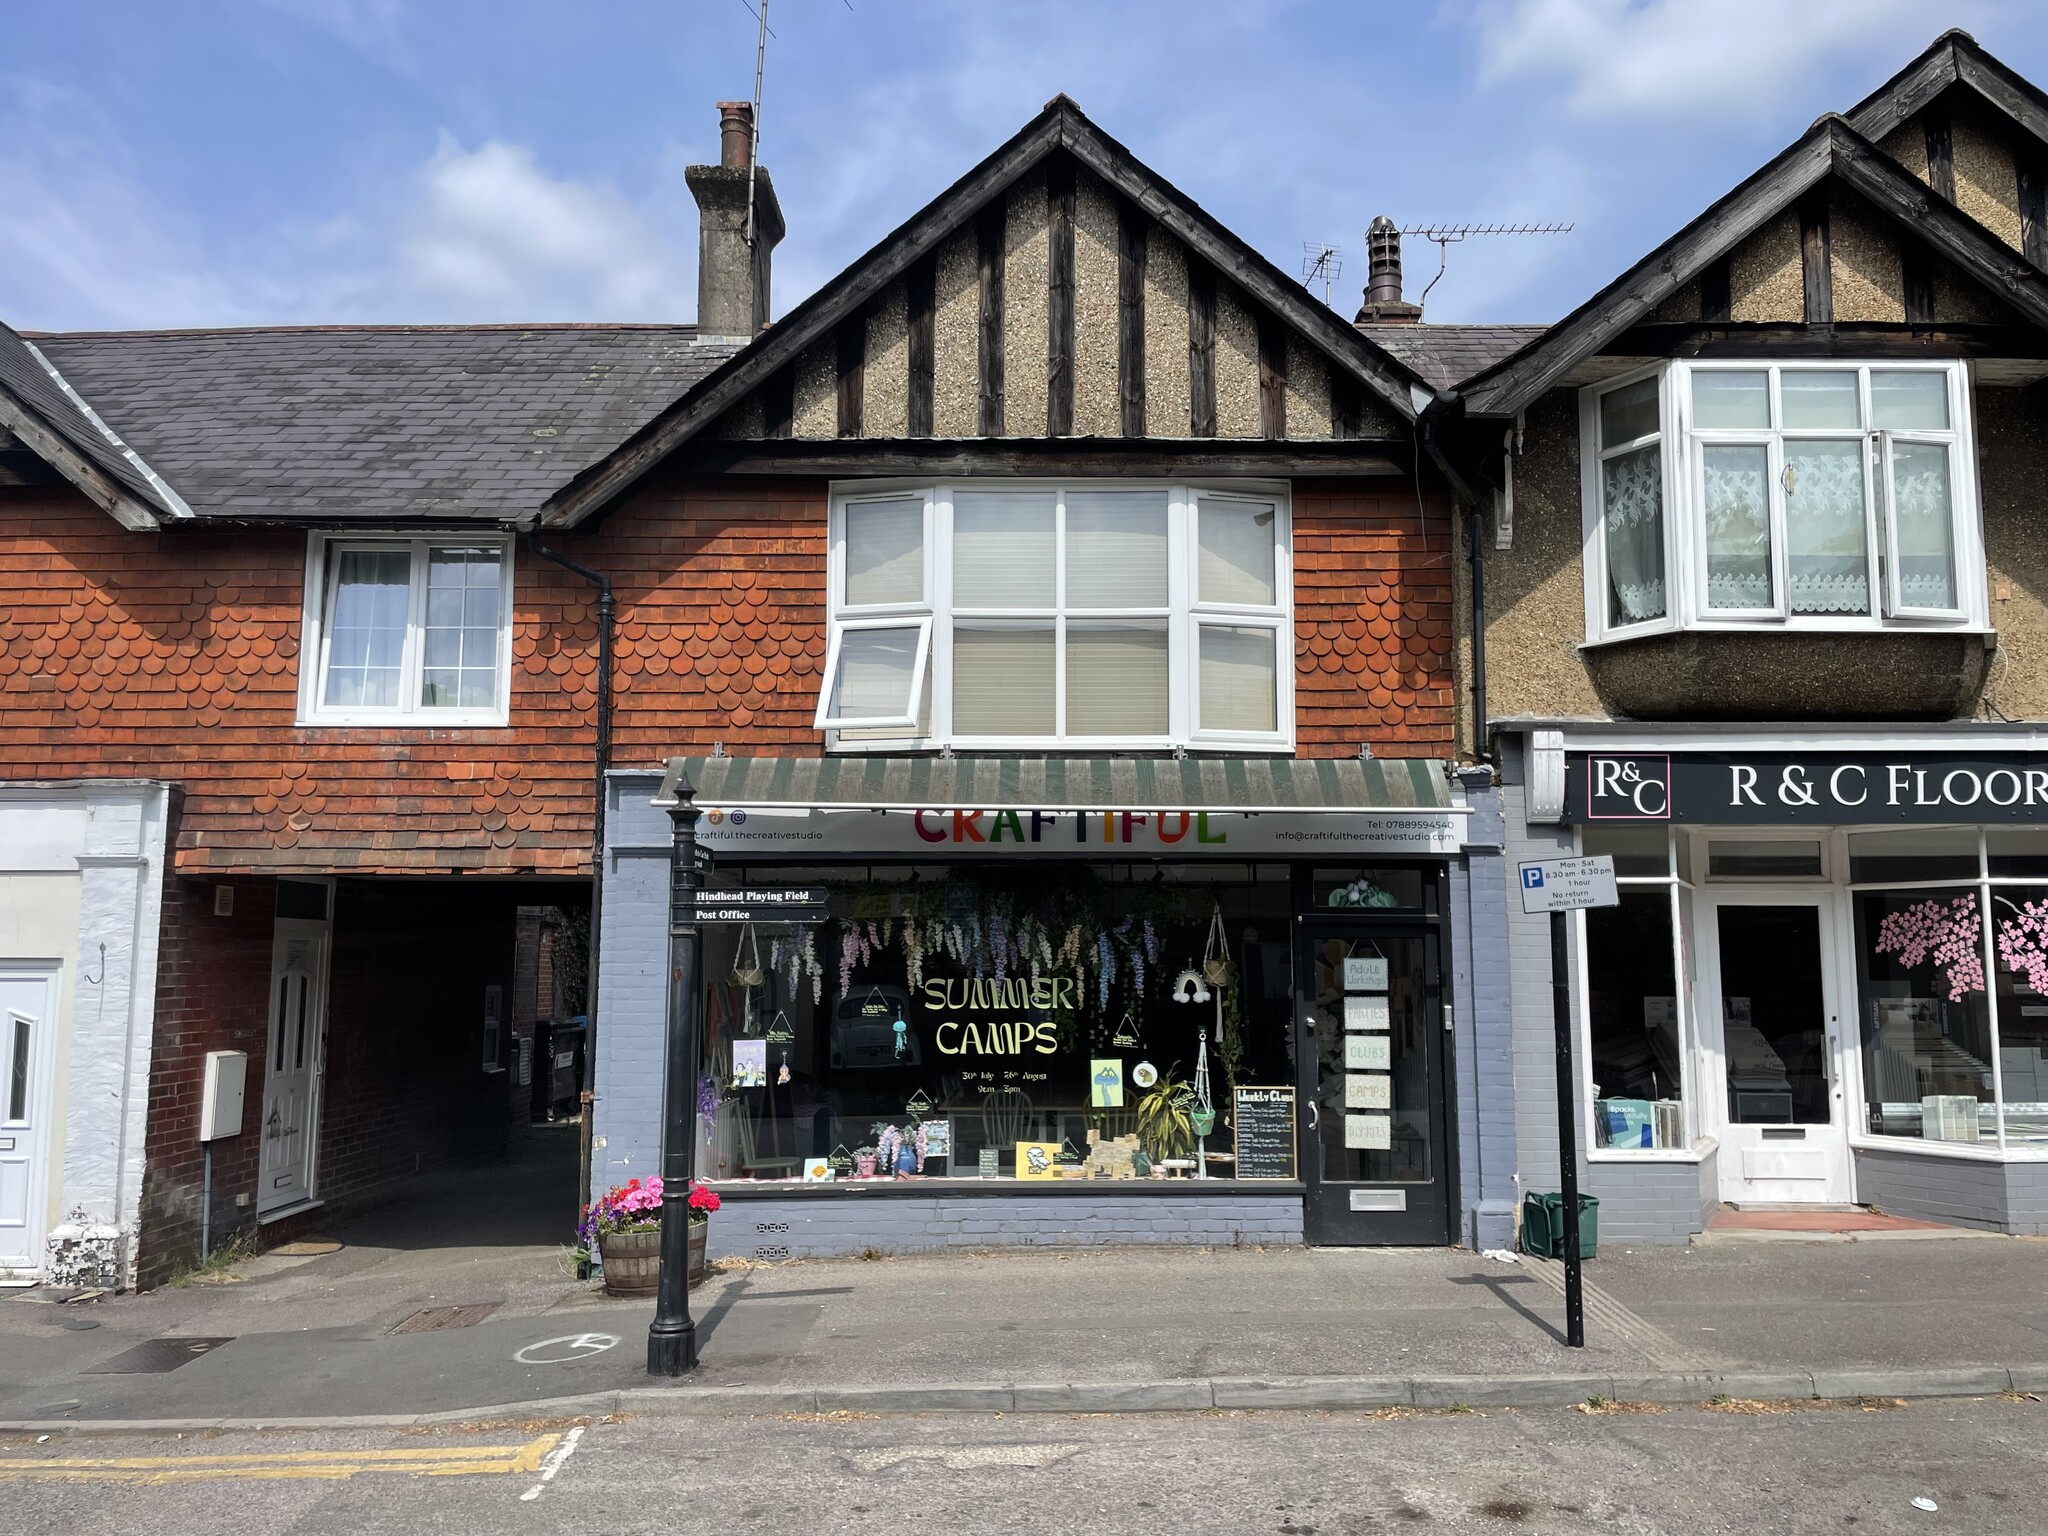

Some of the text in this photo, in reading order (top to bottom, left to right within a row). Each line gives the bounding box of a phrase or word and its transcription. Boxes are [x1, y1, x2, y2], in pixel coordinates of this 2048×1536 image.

[1729, 764, 2048, 806] R & C FLOOR
[1386, 821, 1454, 829] 07889594540
[696, 831, 822, 839] craftiful.thecreativestudio
[1276, 832, 1454, 842] info@craftifulthecreativestudio.com
[1546, 871, 1563, 879] 8.30
[1581, 868, 1599, 876] 6.30
[696, 892, 809, 902] Hindhead Playing Field
[1548, 899, 1570, 907] within
[696, 910, 750, 919] Post Office
[924, 978, 1074, 1010] SUMMER
[1348, 1008, 1385, 1019] PARTIES
[936, 1022, 1058, 1055] CAMPS
[1350, 1047, 1385, 1058] CLUBS
[1022, 1072, 1047, 1081] August
[1237, 1090, 1269, 1102] Weekly
[1349, 1086, 1386, 1098] CAMPS
[1366, 1126, 1386, 1138] KITS
